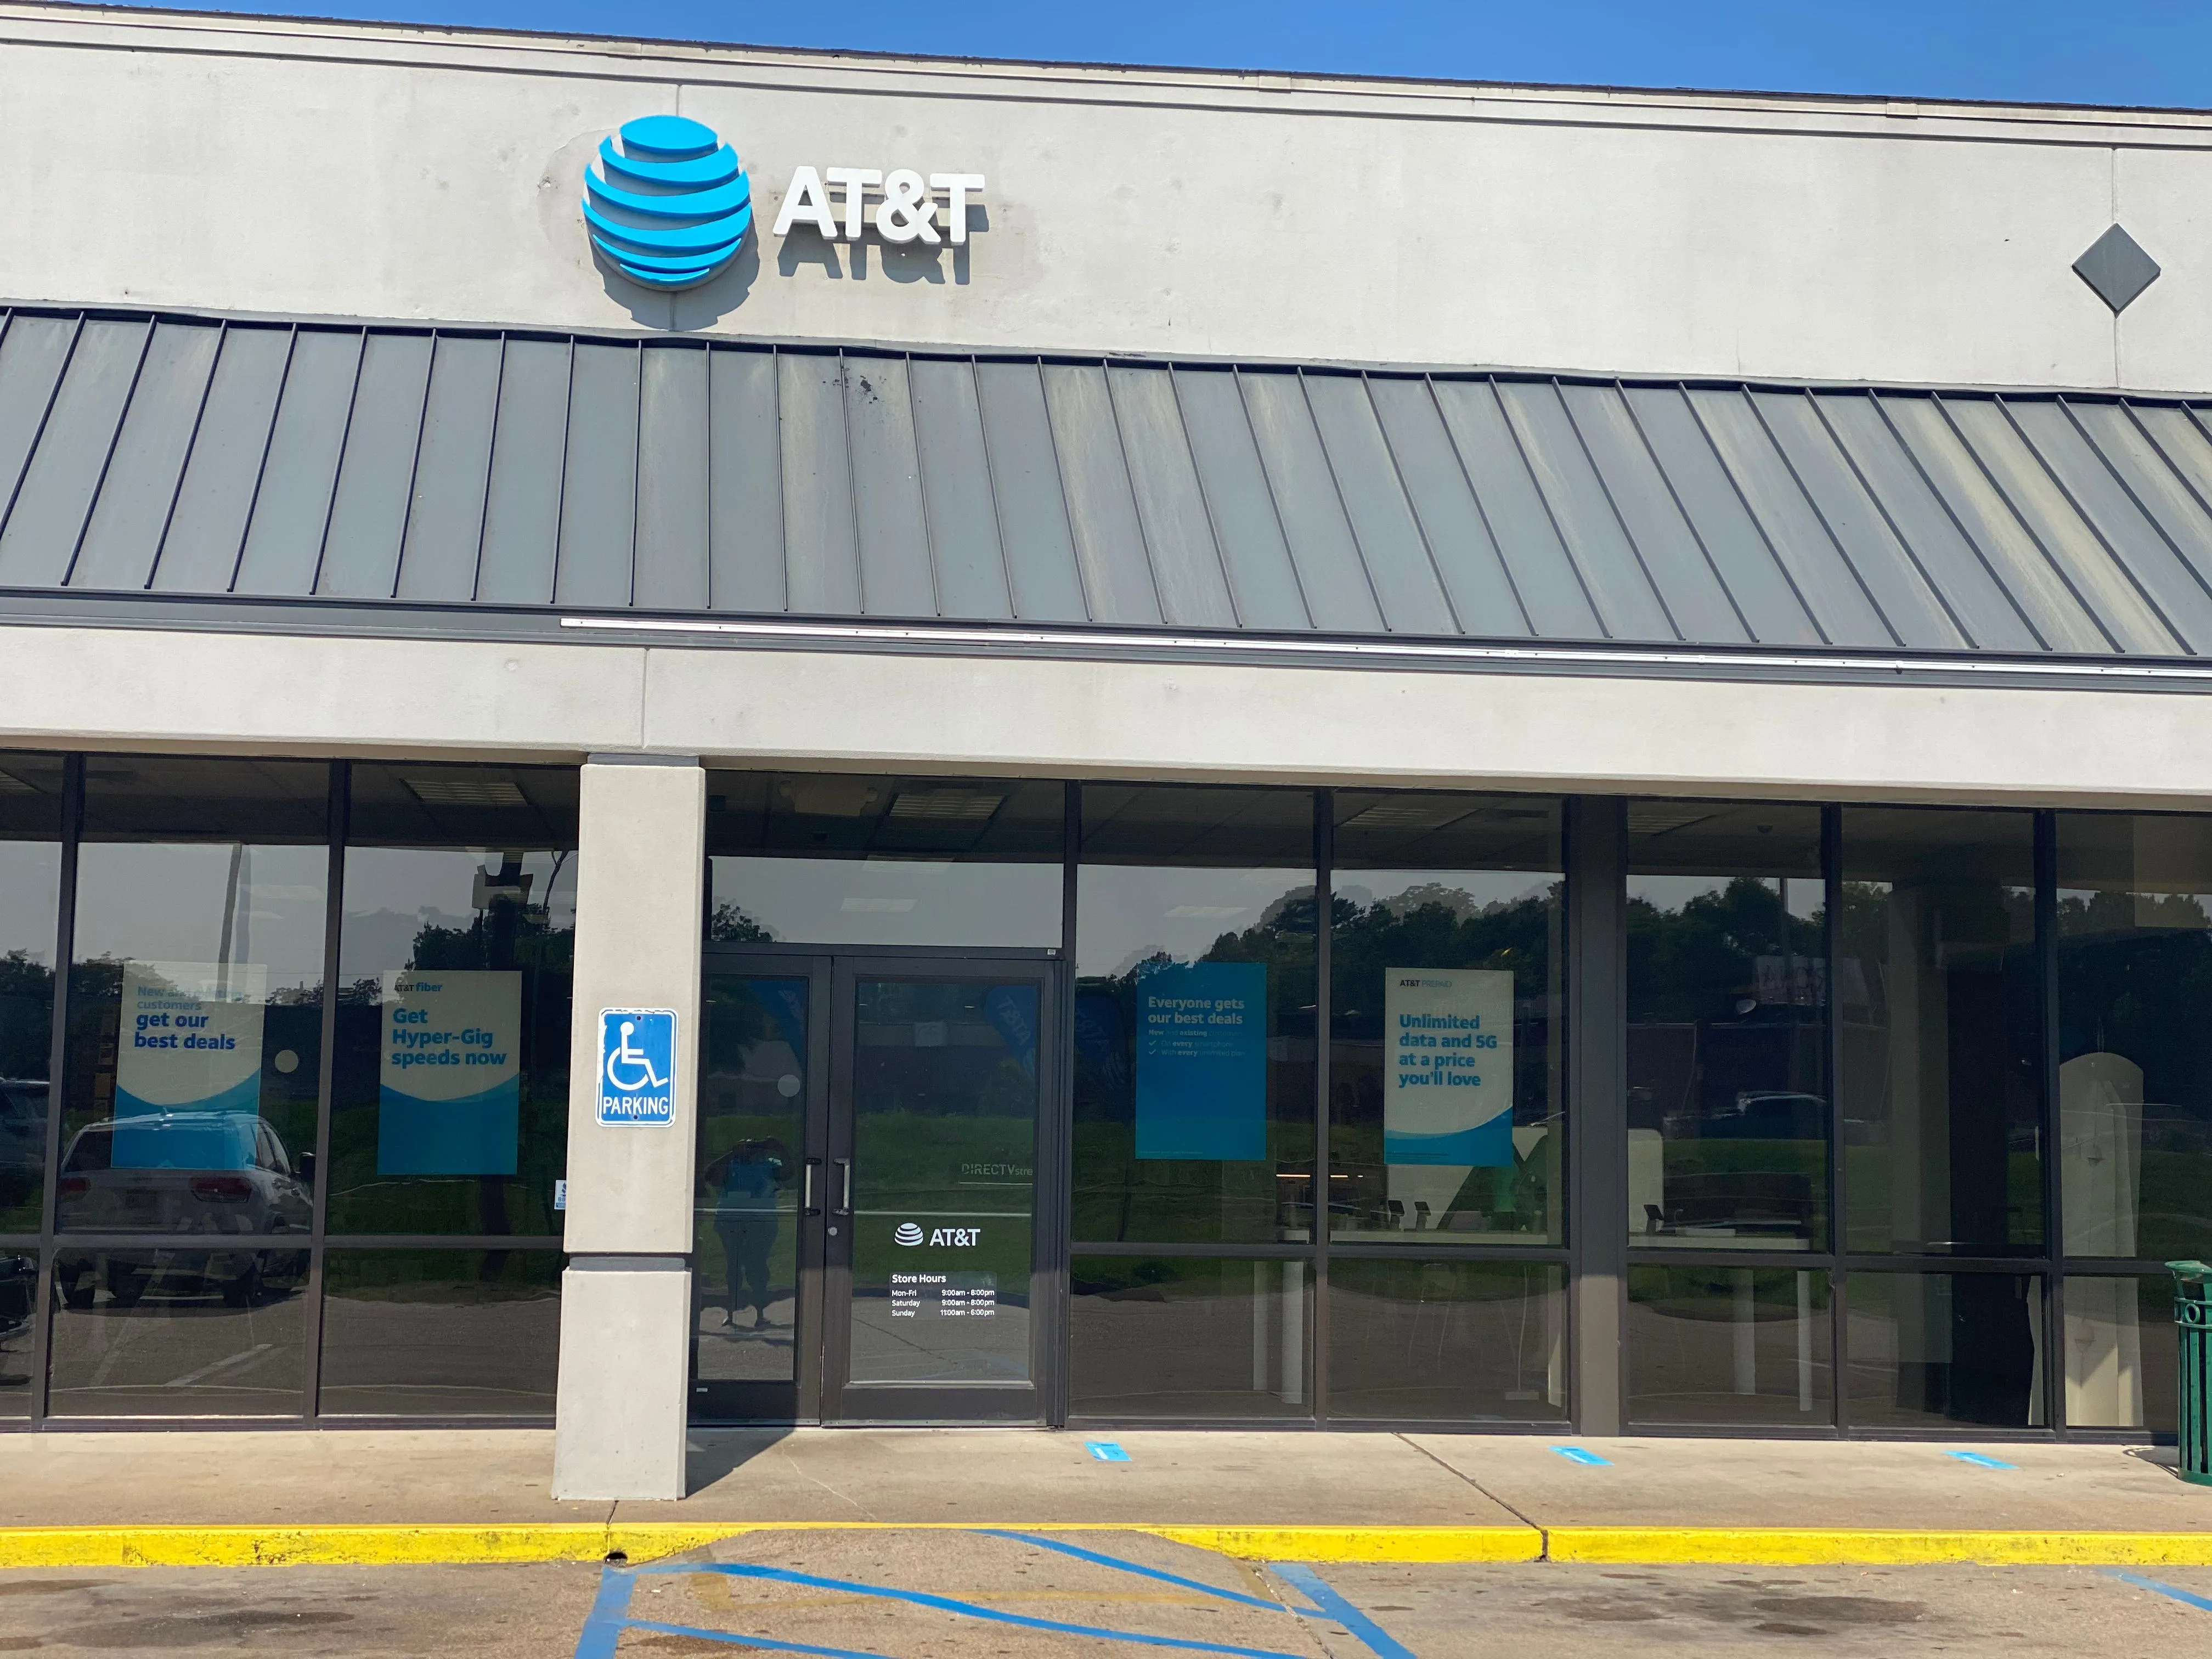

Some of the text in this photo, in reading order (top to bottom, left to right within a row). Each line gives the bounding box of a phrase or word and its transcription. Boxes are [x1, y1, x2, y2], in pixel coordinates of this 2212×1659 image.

[772, 166, 985, 245] AT&T
[137, 986, 165, 997] New
[416, 982, 443, 992] fiber
[137, 1000, 202, 1011] customers
[1148, 996, 1245, 1012] Everyone gets
[136, 1012, 209, 1030] get our
[393, 1008, 428, 1023] Get
[1148, 1012, 1243, 1024] our best deals
[1400, 1014, 1480, 1029] Unlimited
[134, 1032, 236, 1050] best deals
[392, 1028, 494, 1048] Hyper-Gig
[1399, 1032, 1497, 1049] data and 5G
[391, 1049, 507, 1069] speeds now
[1399, 1052, 1476, 1070] at a price
[1398, 1070, 1481, 1088] you'll love
[602, 1097, 668, 1115] PARKING
[929, 1228, 981, 1246] AT&T
[891, 1274, 946, 1283] Store Hours
